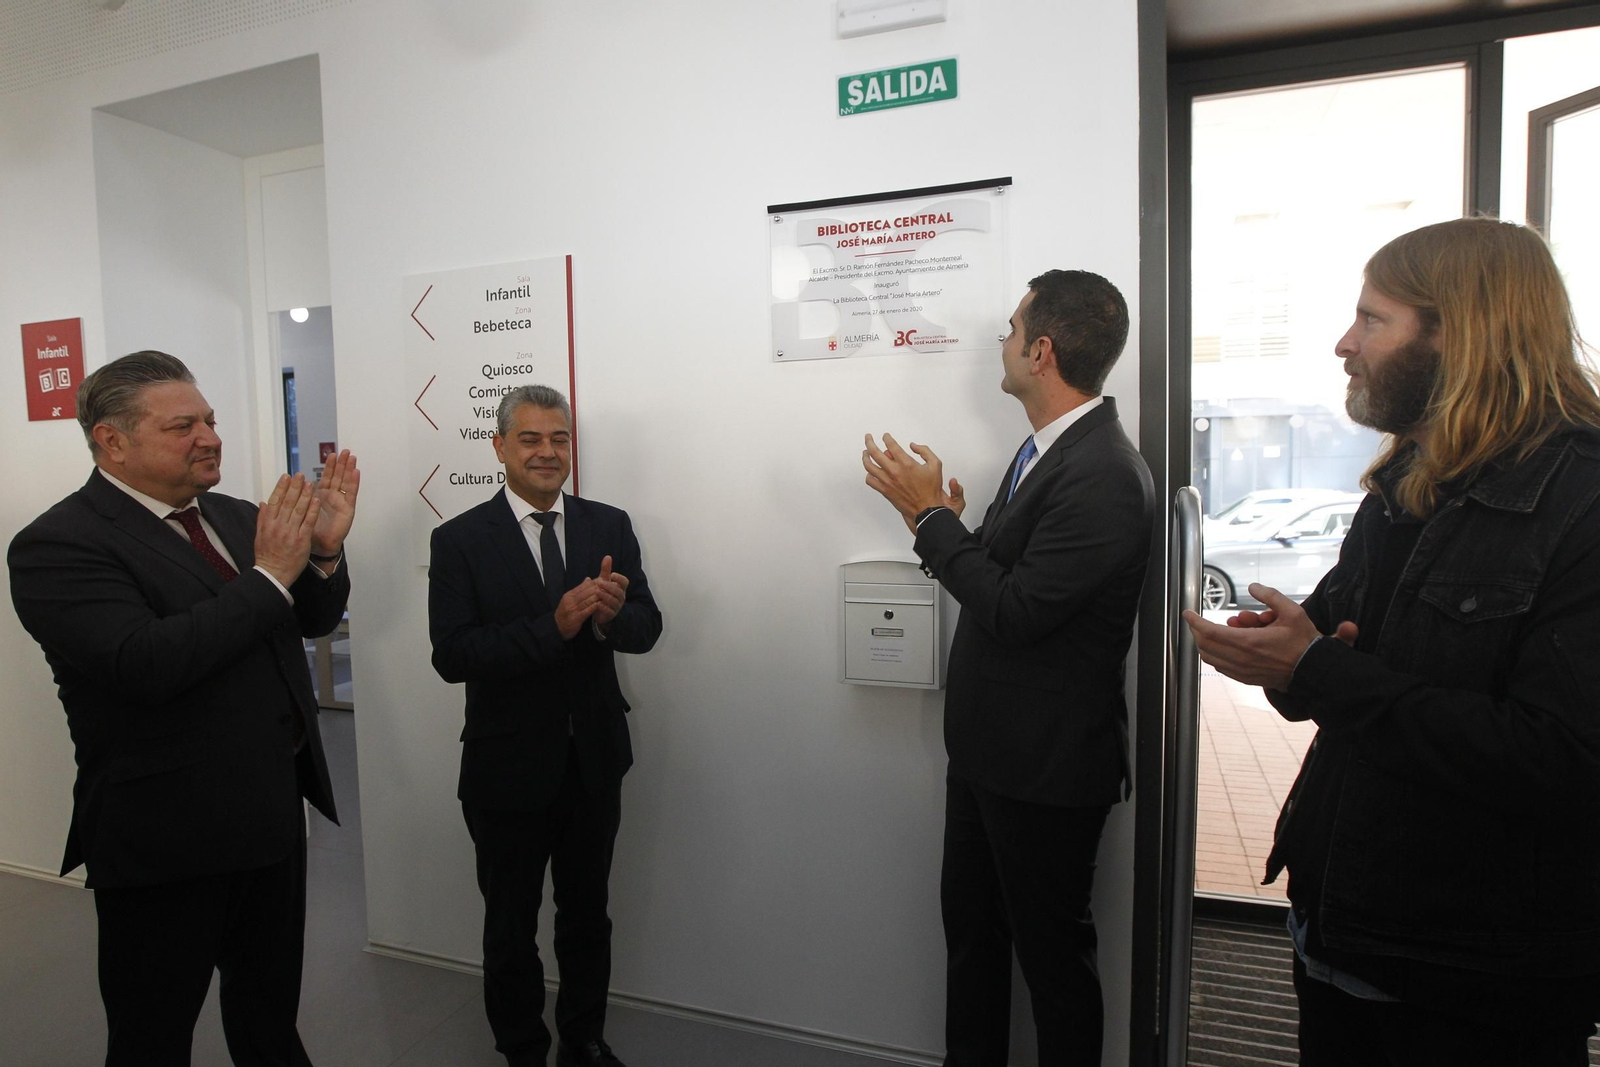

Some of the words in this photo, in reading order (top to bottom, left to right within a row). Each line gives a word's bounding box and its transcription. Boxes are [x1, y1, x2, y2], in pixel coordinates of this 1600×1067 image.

[847, 65, 948, 106] SALIDA
[817, 219, 891, 237] BIBLIOTECA
[893, 212, 954, 229] CENTRAL
[836, 236, 860, 249] JOSÉ
[861, 232, 894, 247] MARÍA
[895, 230, 936, 242] ARTERO
[874, 260, 904, 268] Fernández
[930, 255, 962, 263] Monterreal
[517, 275, 531, 283] Sala
[808, 275, 829, 283] Alcalde
[834, 272, 863, 280] Presidente
[895, 266, 936, 275] Ayuntamiento
[945, 262, 969, 270] Almería
[486, 284, 531, 302] Infantil
[840, 295, 868, 303] Biblioteca
[868, 293, 889, 301] Central
[515, 306, 532, 315] Zona
[473, 319, 532, 333] Bebeteca
[843, 333, 880, 343] ALMERÍA
[37, 345, 69, 359] Infantil
[482, 363, 533, 380] Quiosco
[449, 472, 493, 485] Cultura
